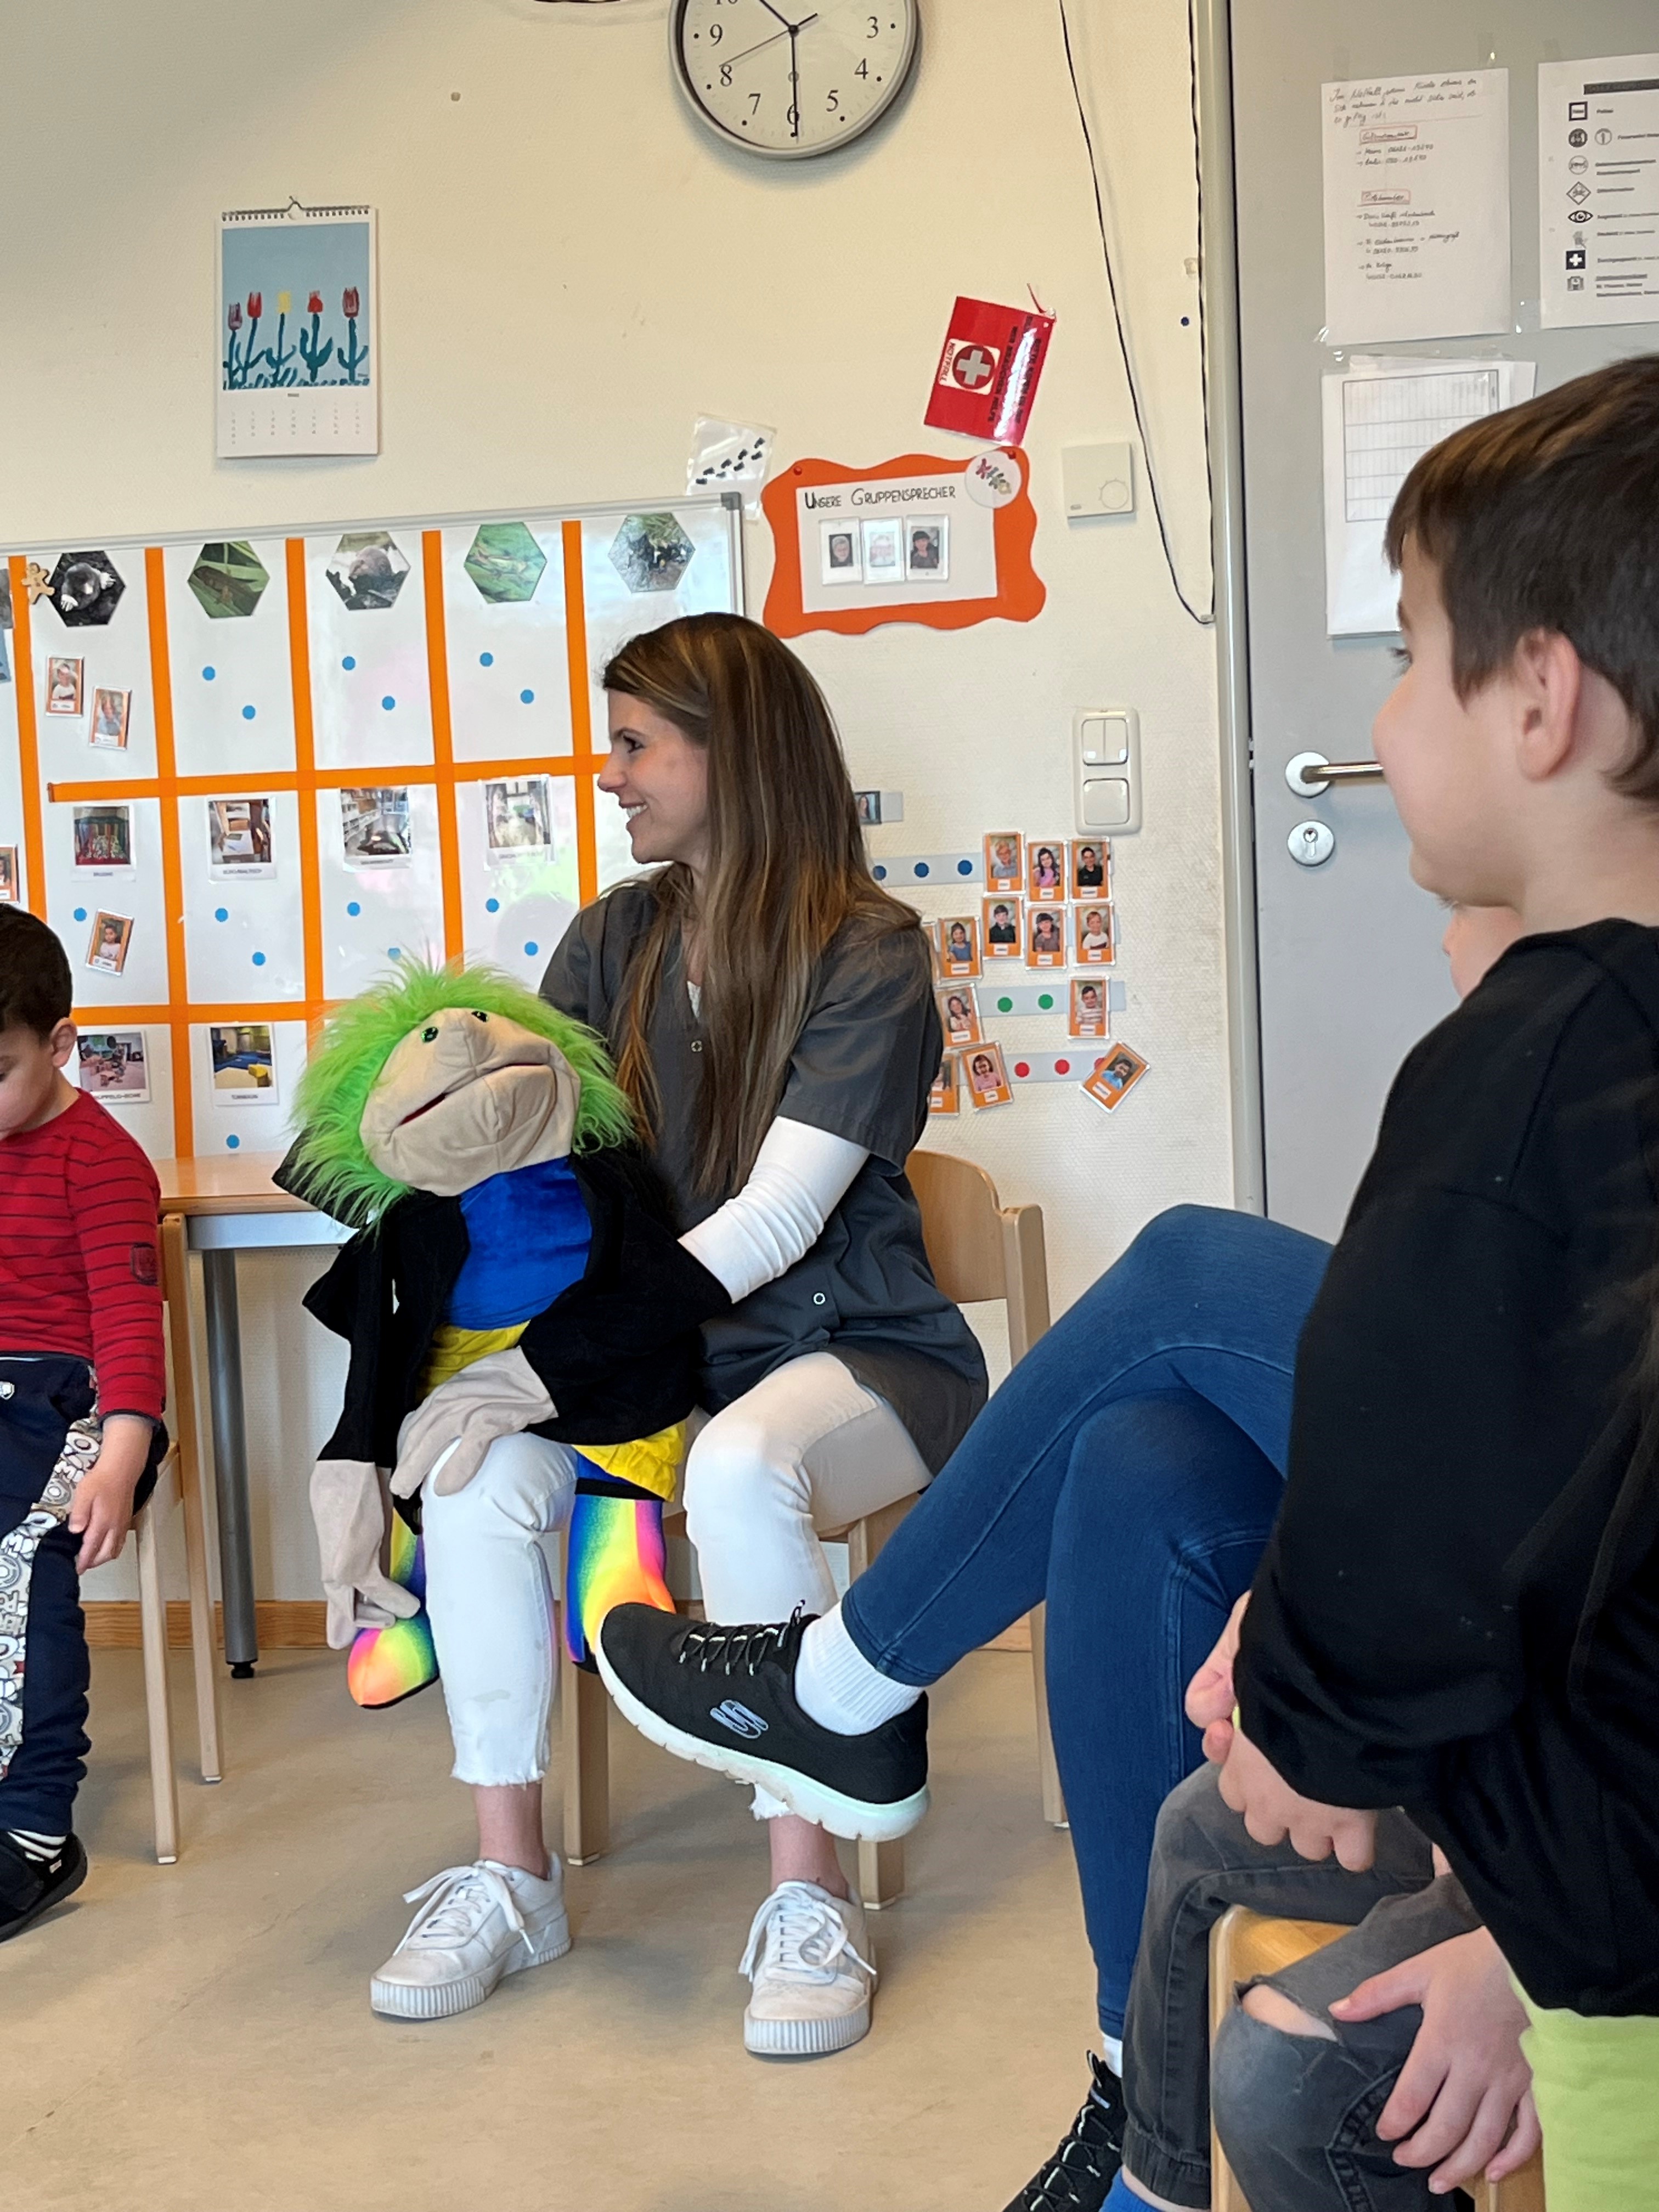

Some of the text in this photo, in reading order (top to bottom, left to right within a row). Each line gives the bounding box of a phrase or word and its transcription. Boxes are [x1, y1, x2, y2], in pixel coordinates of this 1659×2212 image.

[709, 24, 723, 47] 9
[866, 16, 879, 38] 3
[720, 64, 732, 87] 8
[854, 58, 869, 80] 4
[748, 93, 761, 115] 7
[826, 89, 839, 112] 5
[787, 104, 799, 125] 6
[940, 341, 956, 382] NOTFALL
